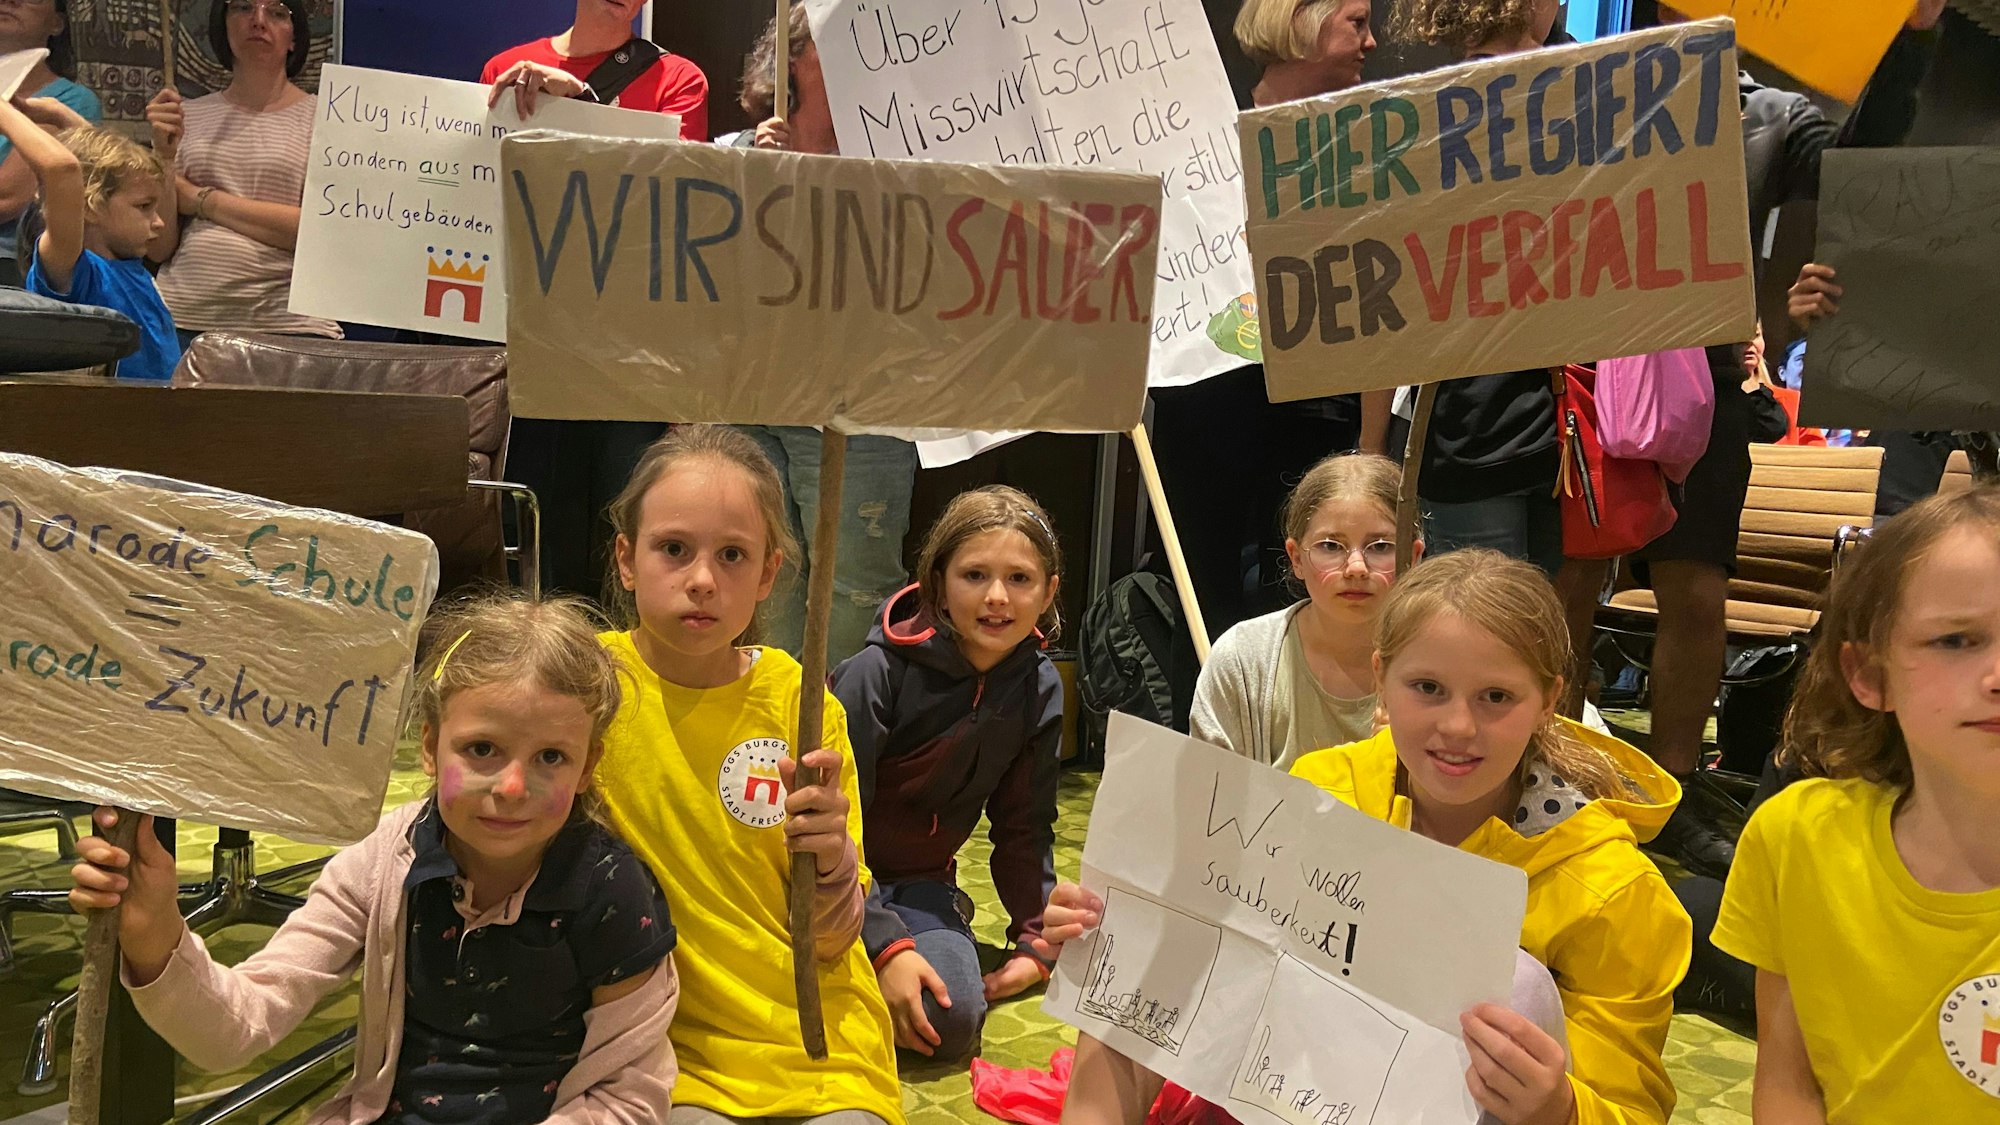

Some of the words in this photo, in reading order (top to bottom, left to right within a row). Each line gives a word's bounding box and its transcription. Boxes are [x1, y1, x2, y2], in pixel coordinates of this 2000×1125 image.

[849, 3, 962, 73] Über
[859, 0, 1191, 157] Misswirtschaft
[326, 81, 389, 132] Klug
[435, 116, 482, 137] wenn
[492, 124, 517, 139] m
[1132, 98, 1191, 147] die
[1257, 97, 1422, 219] HIER
[1436, 31, 1736, 190] REGIERT
[419, 160, 461, 176] aus
[511, 170, 743, 303] WIR
[754, 185, 934, 316] SIND
[936, 196, 1158, 325] SAUER.
[1156, 223, 1243, 282] inder
[1265, 238, 1407, 351] DER
[1404, 181, 1747, 323] VERFALL
[235, 523, 418, 622] Schule
[0, 639, 124, 691] rode
[144, 645, 389, 748] Zukunft
[723, 750, 741, 774] GGS
[721, 786, 746, 819] STADT
[1942, 991, 1967, 1023] GGS
[1945, 1040, 1988, 1086] STADT
